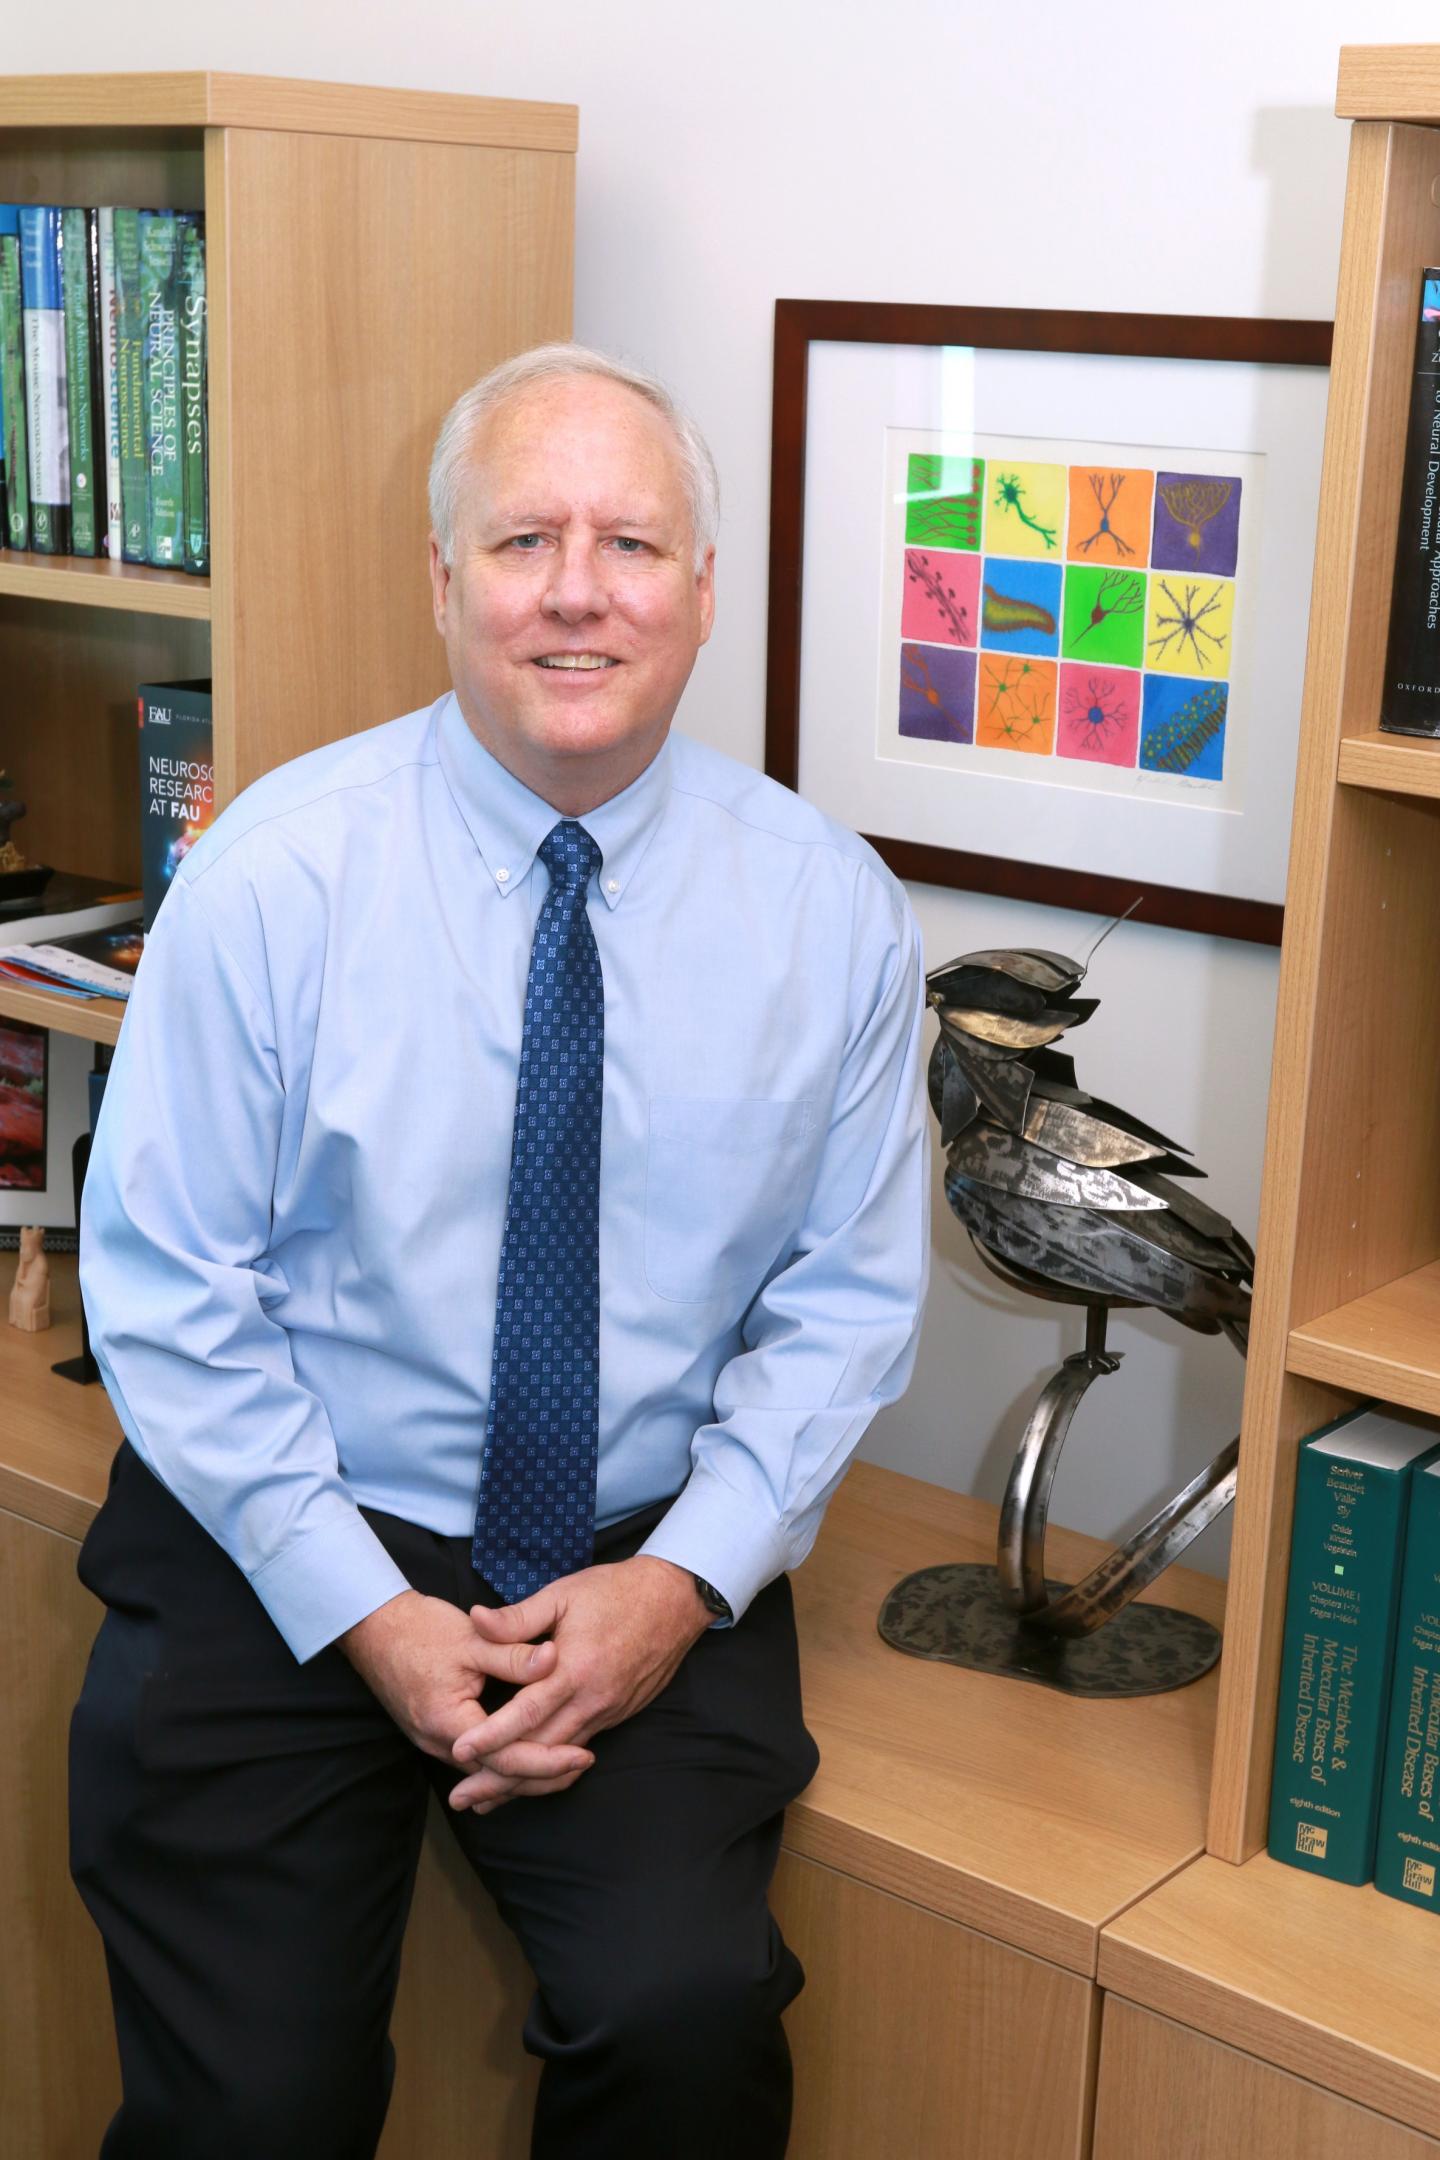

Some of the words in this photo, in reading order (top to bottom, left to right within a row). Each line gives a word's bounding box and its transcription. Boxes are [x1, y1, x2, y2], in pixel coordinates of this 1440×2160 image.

[148, 292, 163, 382] NEURAL
[162, 310, 176, 428] PRINCIPLES
[181, 295, 208, 454] Synapses
[120, 339, 130, 459] Neuroscience
[132, 341, 144, 458] Fundamental
[79, 402, 88, 462] Networks
[150, 388, 164, 476] SCIENCE
[163, 434, 176, 462] OF
[1430, 409, 1440, 454] Neural
[1420, 461, 1440, 550] Development
[1427, 550, 1440, 629] Approaches
[1397, 682, 1440, 694] OXFORD
[149, 706, 171, 722] FAU
[149, 777, 213, 804] RESEARC
[149, 798, 168, 816] AT
[171, 801, 200, 821] FAU
[1326, 1477, 1366, 1494] Beaudet
[1330, 1465, 1364, 1480] Scriver
[1334, 1492, 1357, 1505] Valle
[1337, 1505, 1351, 1518] Sly
[1312, 1581, 1356, 1600] VOLUME
[1310, 1607, 1332, 1620] Pages
[1298, 1633, 1319, 1702] Inherited
[1317, 1638, 1339, 1716] Molecular
[1341, 1646, 1358, 1675] The
[1333, 1677, 1354, 1754] Metabolic
[1408, 1665, 1429, 1736] Inherited
[1426, 1673, 1440, 1750] Molecular
[1292, 1703, 1313, 1763] Disease
[1312, 1717, 1331, 1763] Bases
[1310, 1765, 1327, 1786] of
[1331, 1757, 1347, 1770] &
[1401, 1736, 1421, 1797] Disease
[1420, 1752, 1440, 1798] Bases
[1289, 1797, 1314, 1810] eighth
[1314, 1804, 1341, 1818] edition
[1418, 1800, 1434, 1822] of
[1397, 1832, 1421, 1846] eighth
